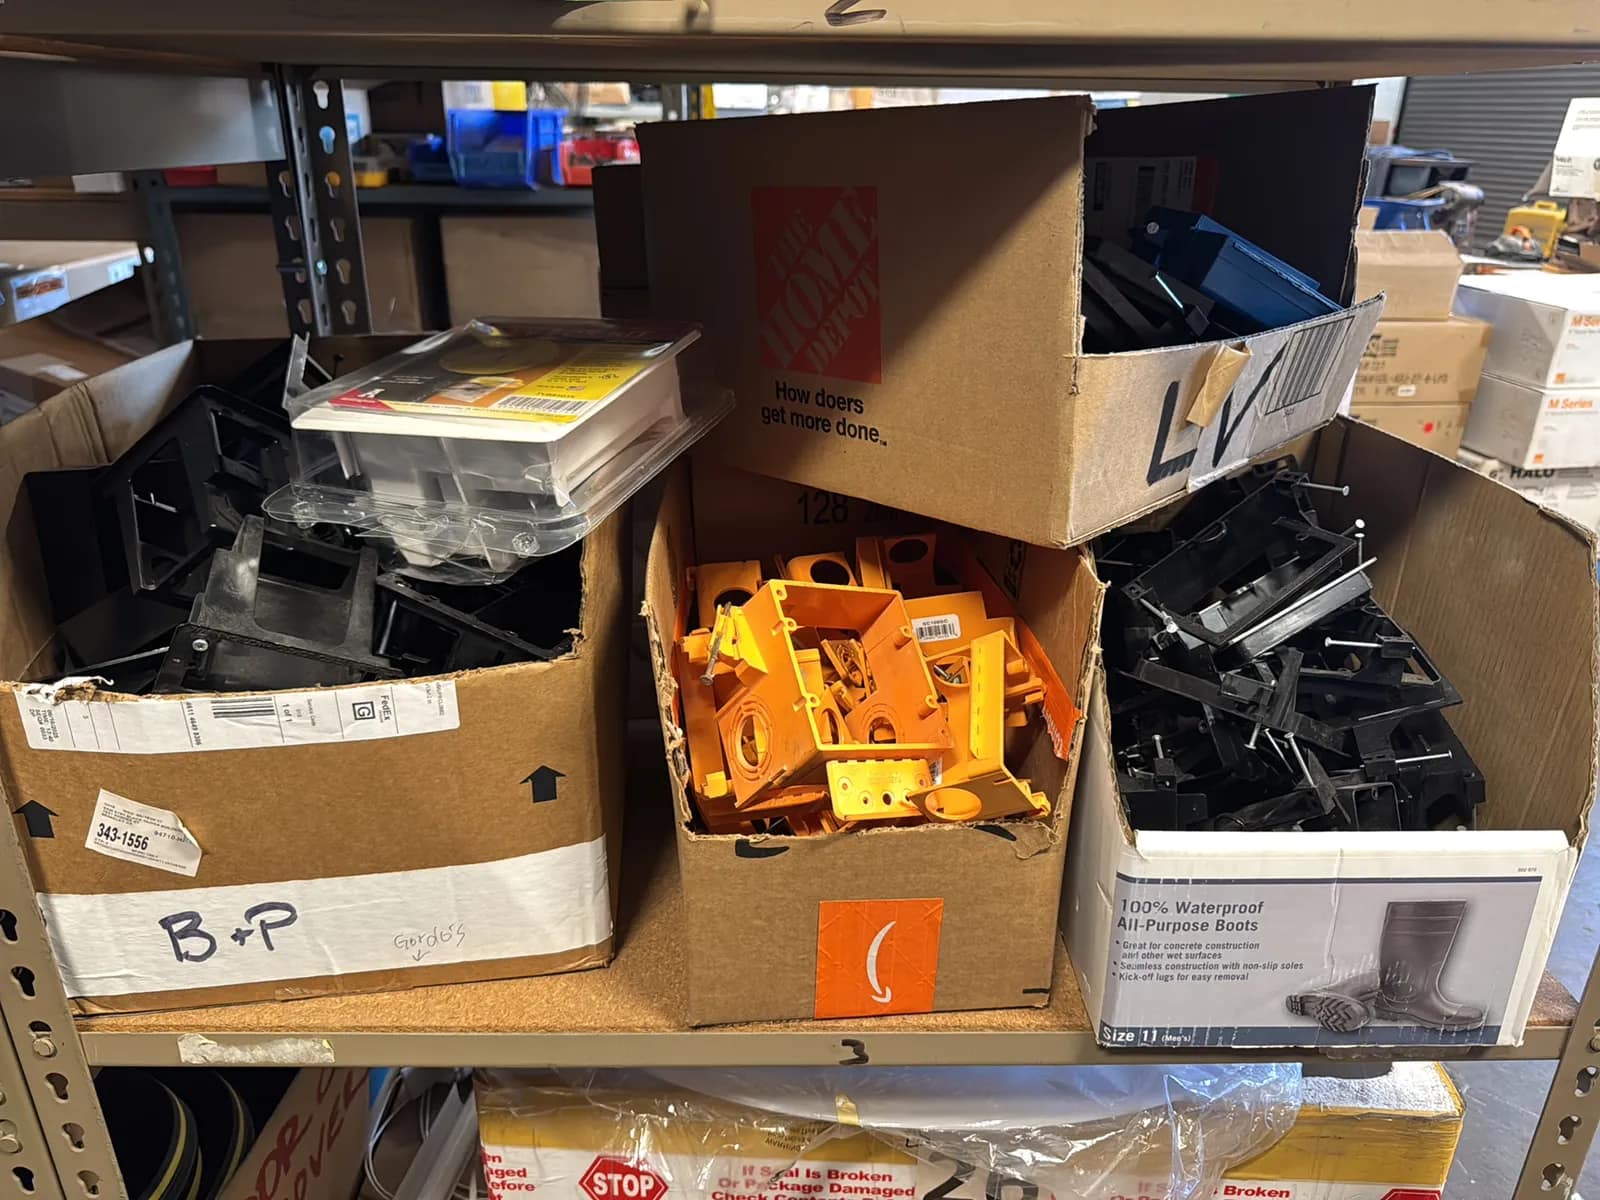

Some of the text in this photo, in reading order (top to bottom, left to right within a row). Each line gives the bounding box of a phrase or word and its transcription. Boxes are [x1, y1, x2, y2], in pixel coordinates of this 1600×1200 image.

[760, 188, 880, 368] HOME
[803, 262, 881, 375] DEPOT
[775, 380, 864, 415] How doers
[1548, 399, 1560, 408] M
[761, 405, 787, 425] get
[790, 411, 832, 433] more
[357, 706, 371, 717] G
[381, 695, 392, 721] FedEx
[97, 822, 149, 851] 343-1556
[1119, 898, 1265, 917] 100% Waterproof
[158, 911, 217, 963] B
[244, 901, 298, 951] P
[1117, 916, 1259, 934] All-Purpose Boots
[1122, 941, 1261, 951] Great for concrete construction
[1141, 951, 1165, 960] other
[1185, 951, 1223, 960] surfaces
[1164, 961, 1219, 971] construction
[1221, 960, 1241, 970] with
[1242, 961, 1279, 972] non-slip
[1280, 961, 1305, 970] soles
[1118, 972, 1250, 984] Kick-off lugs for easy removal
[1102, 1026, 1136, 1043] Size
[1142, 1030, 1158, 1042] 11
[839, 1038, 870, 1066] 3
[742, 1165, 893, 1182] If Sal Is Broken
[592, 1172, 655, 1197] STOP
[718, 1177, 740, 1188] Or
[829, 1183, 916, 1197] Damaged
[1223, 1184, 1290, 1198] Broken
